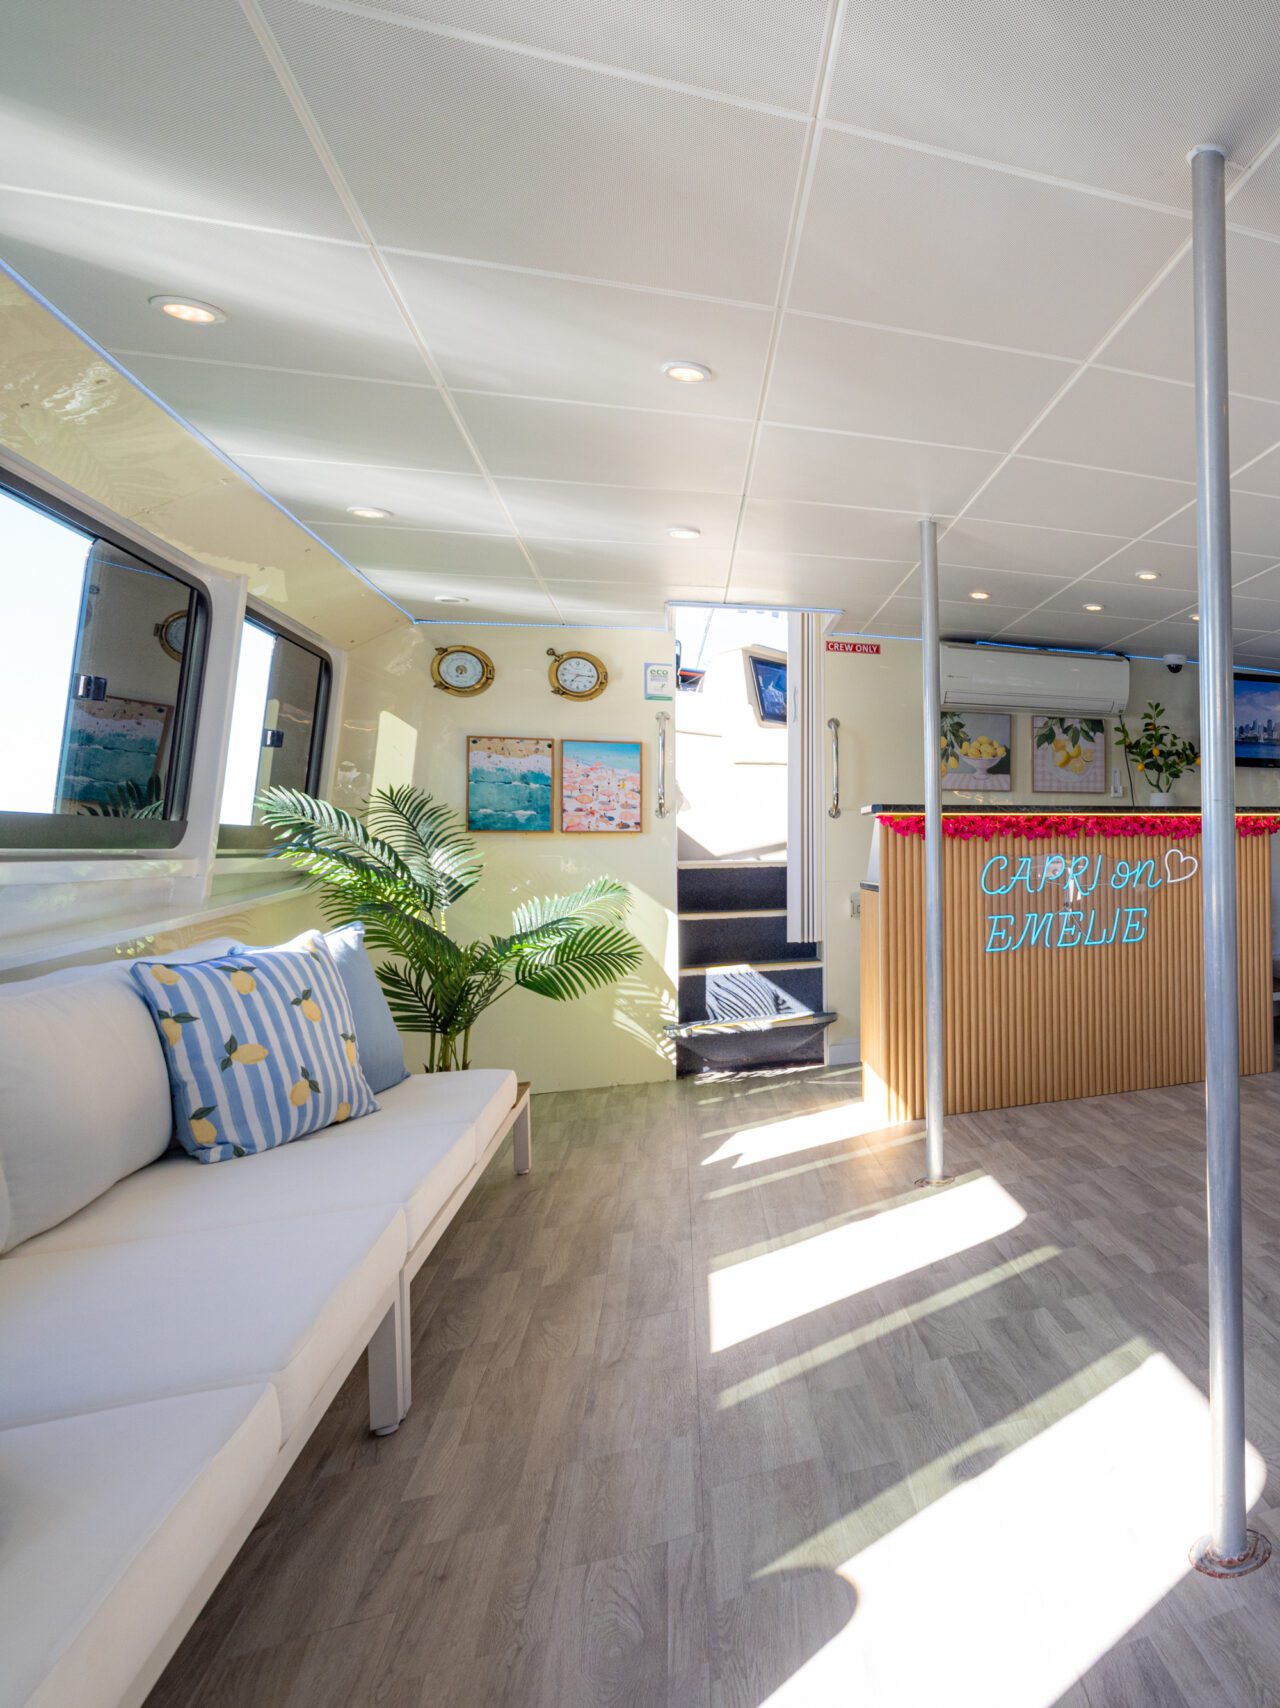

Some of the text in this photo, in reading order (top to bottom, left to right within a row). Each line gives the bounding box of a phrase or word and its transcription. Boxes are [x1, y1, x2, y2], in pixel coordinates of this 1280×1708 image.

[828, 642, 877, 653] CREW ONLY
[981, 854, 1162, 896] CAPRI on
[985, 906, 1148, 953] EMELIE
